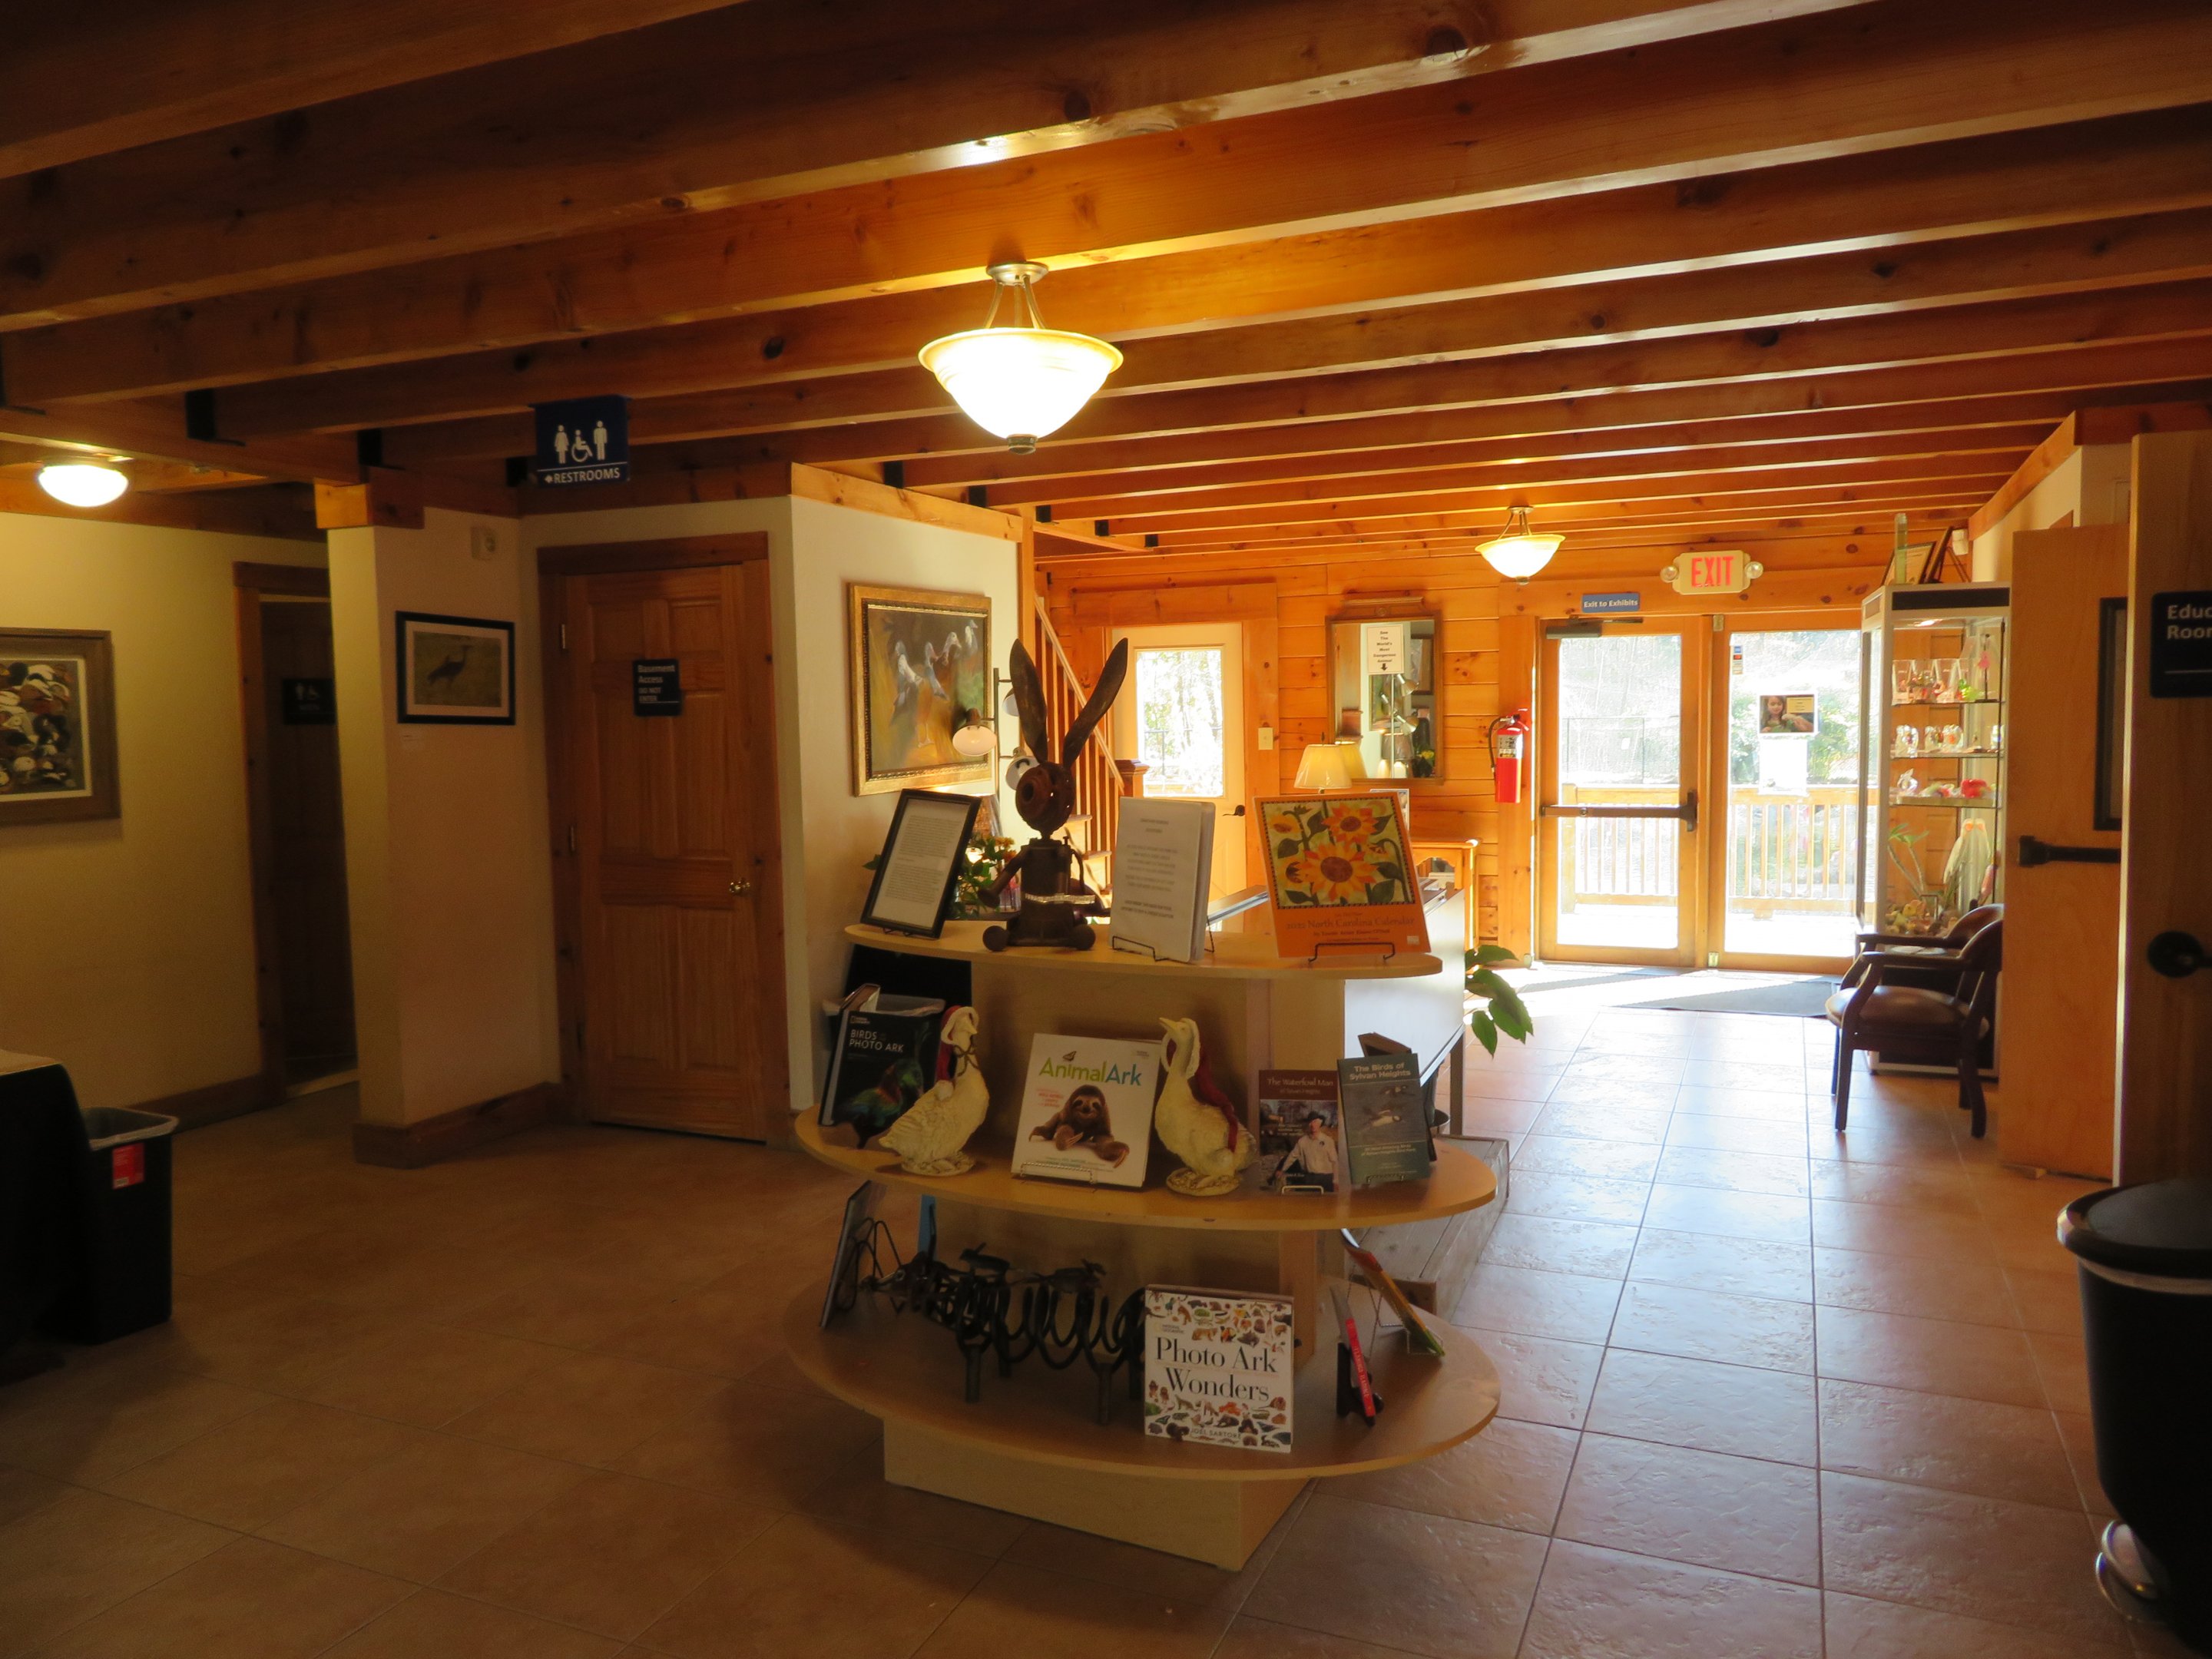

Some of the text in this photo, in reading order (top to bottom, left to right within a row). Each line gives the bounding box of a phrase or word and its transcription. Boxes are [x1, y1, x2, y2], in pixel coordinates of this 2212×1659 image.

[554, 468, 621, 484] RESTROOMS
[1691, 556, 1734, 588] EXIT
[1307, 918, 1333, 929] North
[1335, 917, 1373, 927] Carolina
[1375, 916, 1415, 926] Calendar
[849, 1028, 878, 1041] BIRDS
[849, 1038, 905, 1053] PHOTO ARK
[1267, 1076, 1333, 1087] The Waterfowl Man
[1349, 1069, 1412, 1081] Sylvan Heights
[1157, 1336, 1278, 1373] Photo Ark
[1165, 1367, 1270, 1402] Wonders
